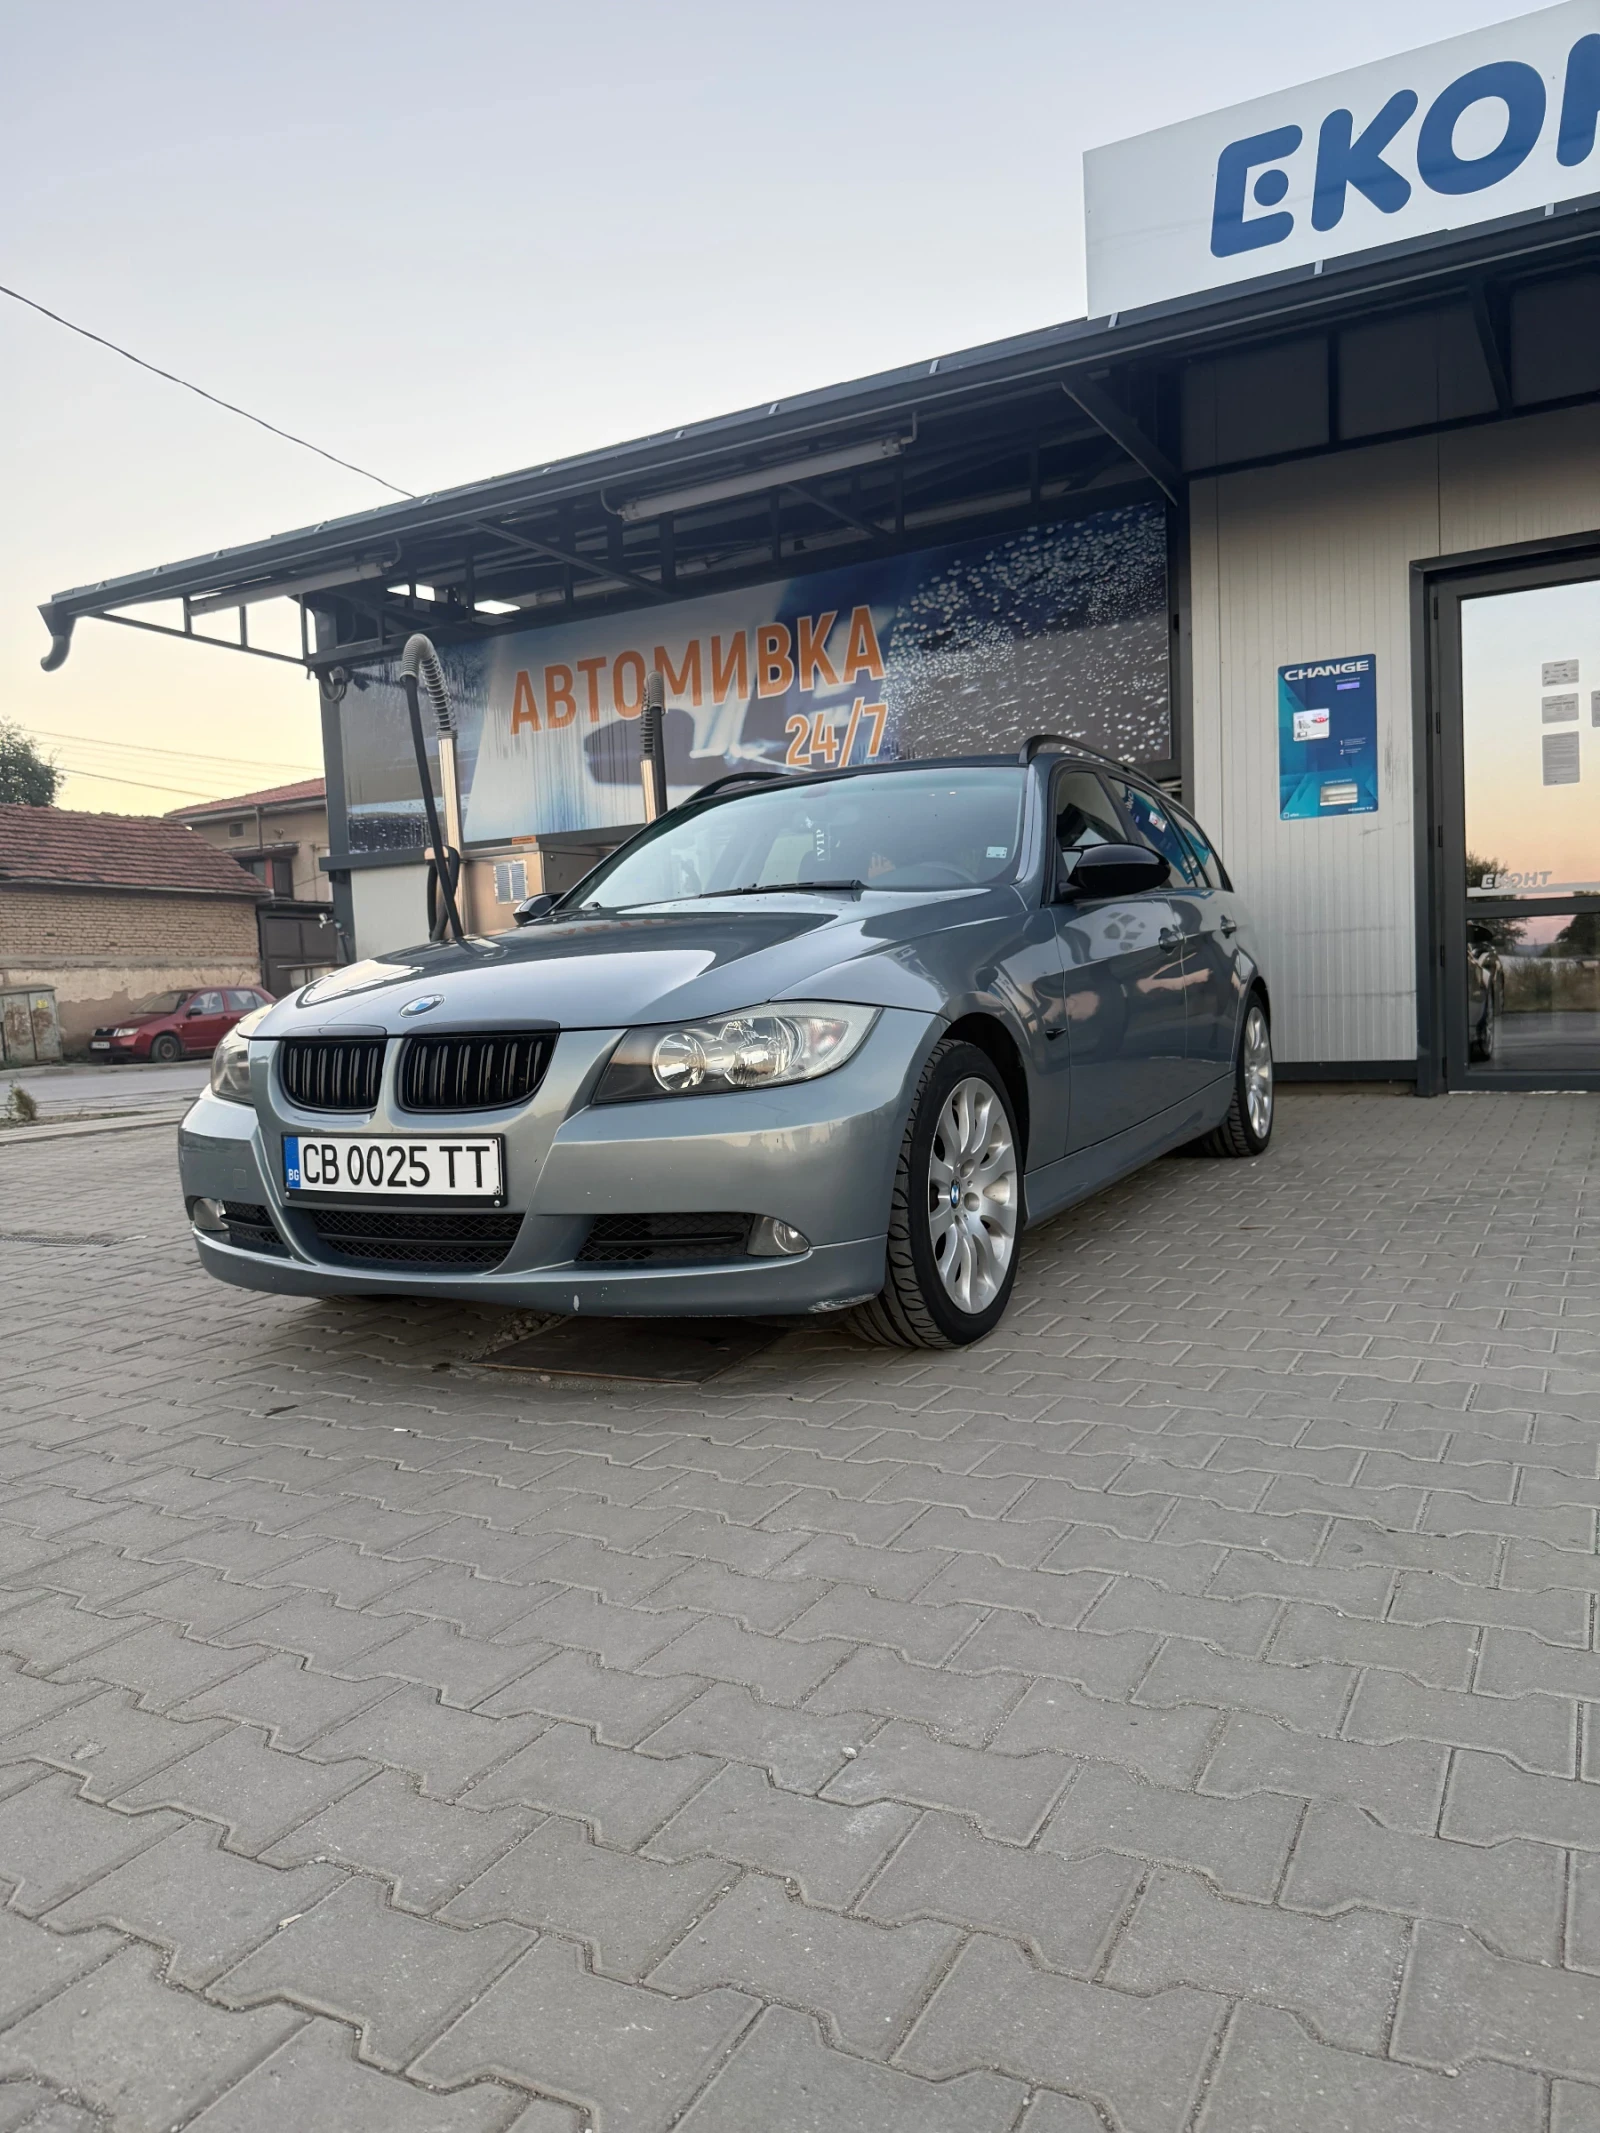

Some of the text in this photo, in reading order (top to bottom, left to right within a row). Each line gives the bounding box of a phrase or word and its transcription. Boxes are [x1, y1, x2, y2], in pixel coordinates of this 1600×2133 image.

[510, 604, 886, 736] АВТОМИВКА
[1284, 660, 1369, 681] CHANGE
[785, 697, 889, 768] 24/7
[288, 1168, 300, 1181] BG
[303, 1144, 490, 1188] CB 0025 TT
